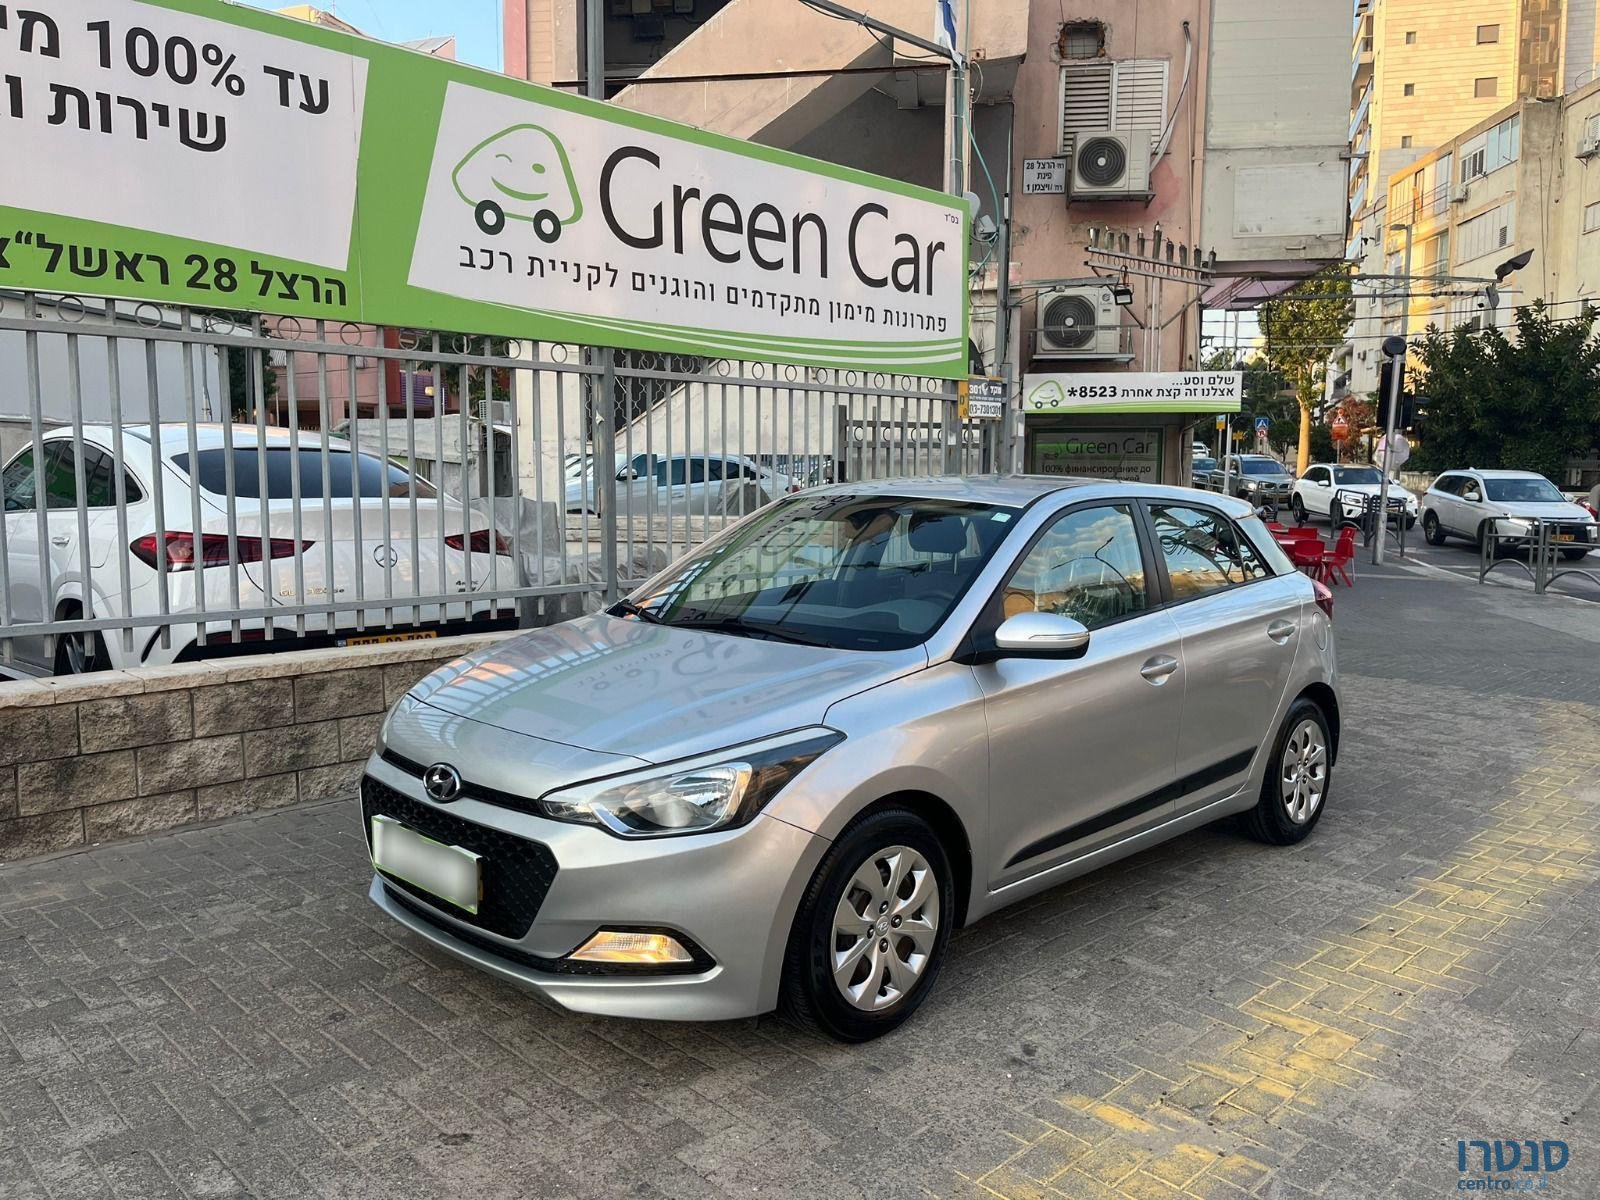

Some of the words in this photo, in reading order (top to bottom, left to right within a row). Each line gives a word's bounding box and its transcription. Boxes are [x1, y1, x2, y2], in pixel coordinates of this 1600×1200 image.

[87, 20, 246, 97] 100%
[263, 65, 330, 114] עד
[47, 82, 227, 153] שירות
[1037, 161, 1055, 169] הרצל
[1037, 172, 1052, 180] פינת
[600, 145, 828, 279] Green
[848, 202, 945, 297] Car
[944, 213, 960, 225] בס"ד
[459, 245, 513, 274] רכב
[185, 253, 238, 293] 28
[250, 260, 348, 307] הרצל
[527, 255, 619, 291] לקניית
[631, 271, 716, 302] והוגנים
[726, 285, 820, 317] מתקדמים
[829, 301, 876, 324] מימון
[883, 308, 947, 333] פתרונות
[970, 385, 982, 395] 301
[1208, 375, 1235, 385] שלם
[1121, 388, 1152, 398] אחרת
[1156, 388, 1181, 400] קצת
[1184, 388, 1198, 397] זה
[1201, 387, 1234, 397] אצלנו
[1066, 438, 1118, 454] Green
[1123, 437, 1153, 454] Car
[1041, 464, 1064, 473] 100%
[1064, 463, 1138, 475] финансирование
[1139, 464, 1152, 474] до
